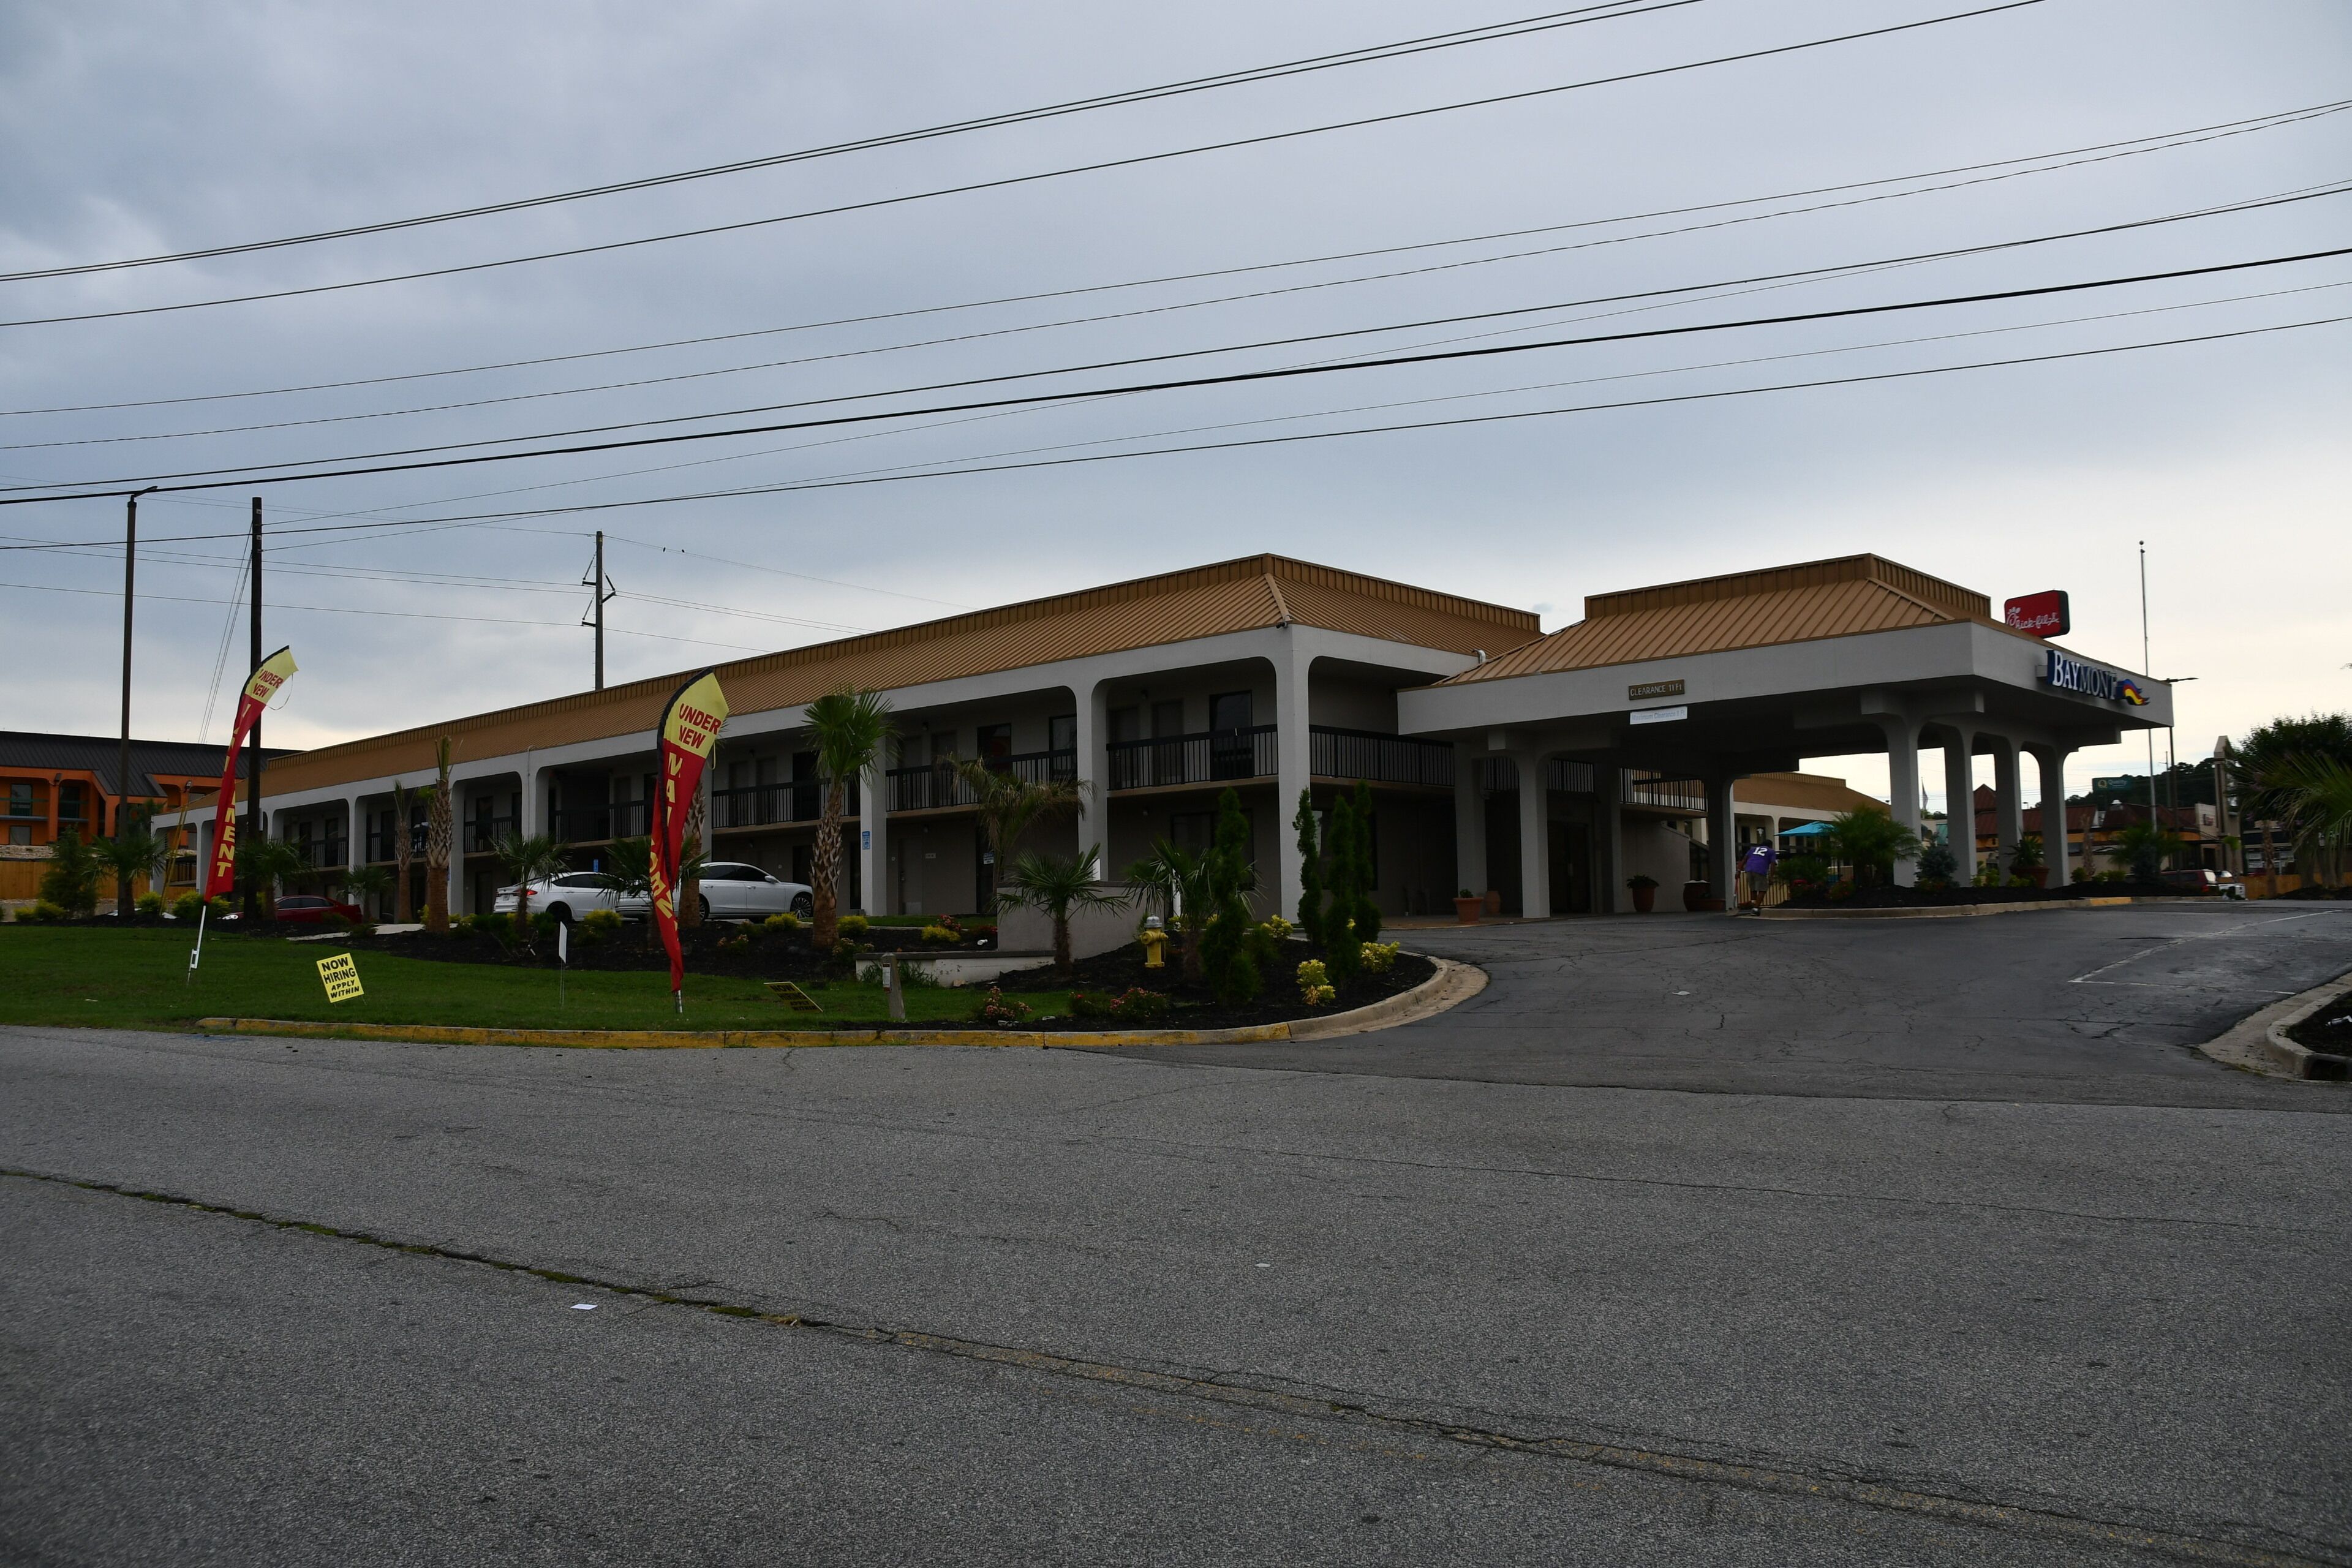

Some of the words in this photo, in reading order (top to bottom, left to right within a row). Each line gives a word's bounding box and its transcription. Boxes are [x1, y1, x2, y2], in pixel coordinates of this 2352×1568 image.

[2052, 650, 2117, 700] BAYMONT
[1630, 685, 1666, 696] CLEARANCE
[679, 703, 722, 735] UNDER
[679, 725, 706, 749] NEW
[1752, 846, 1768, 857] 12
[322, 957, 349, 972] NOW
[323, 968, 356, 984] HIRING
[330, 986, 360, 999] WITHIN
[331, 979, 355, 991] APPLY
